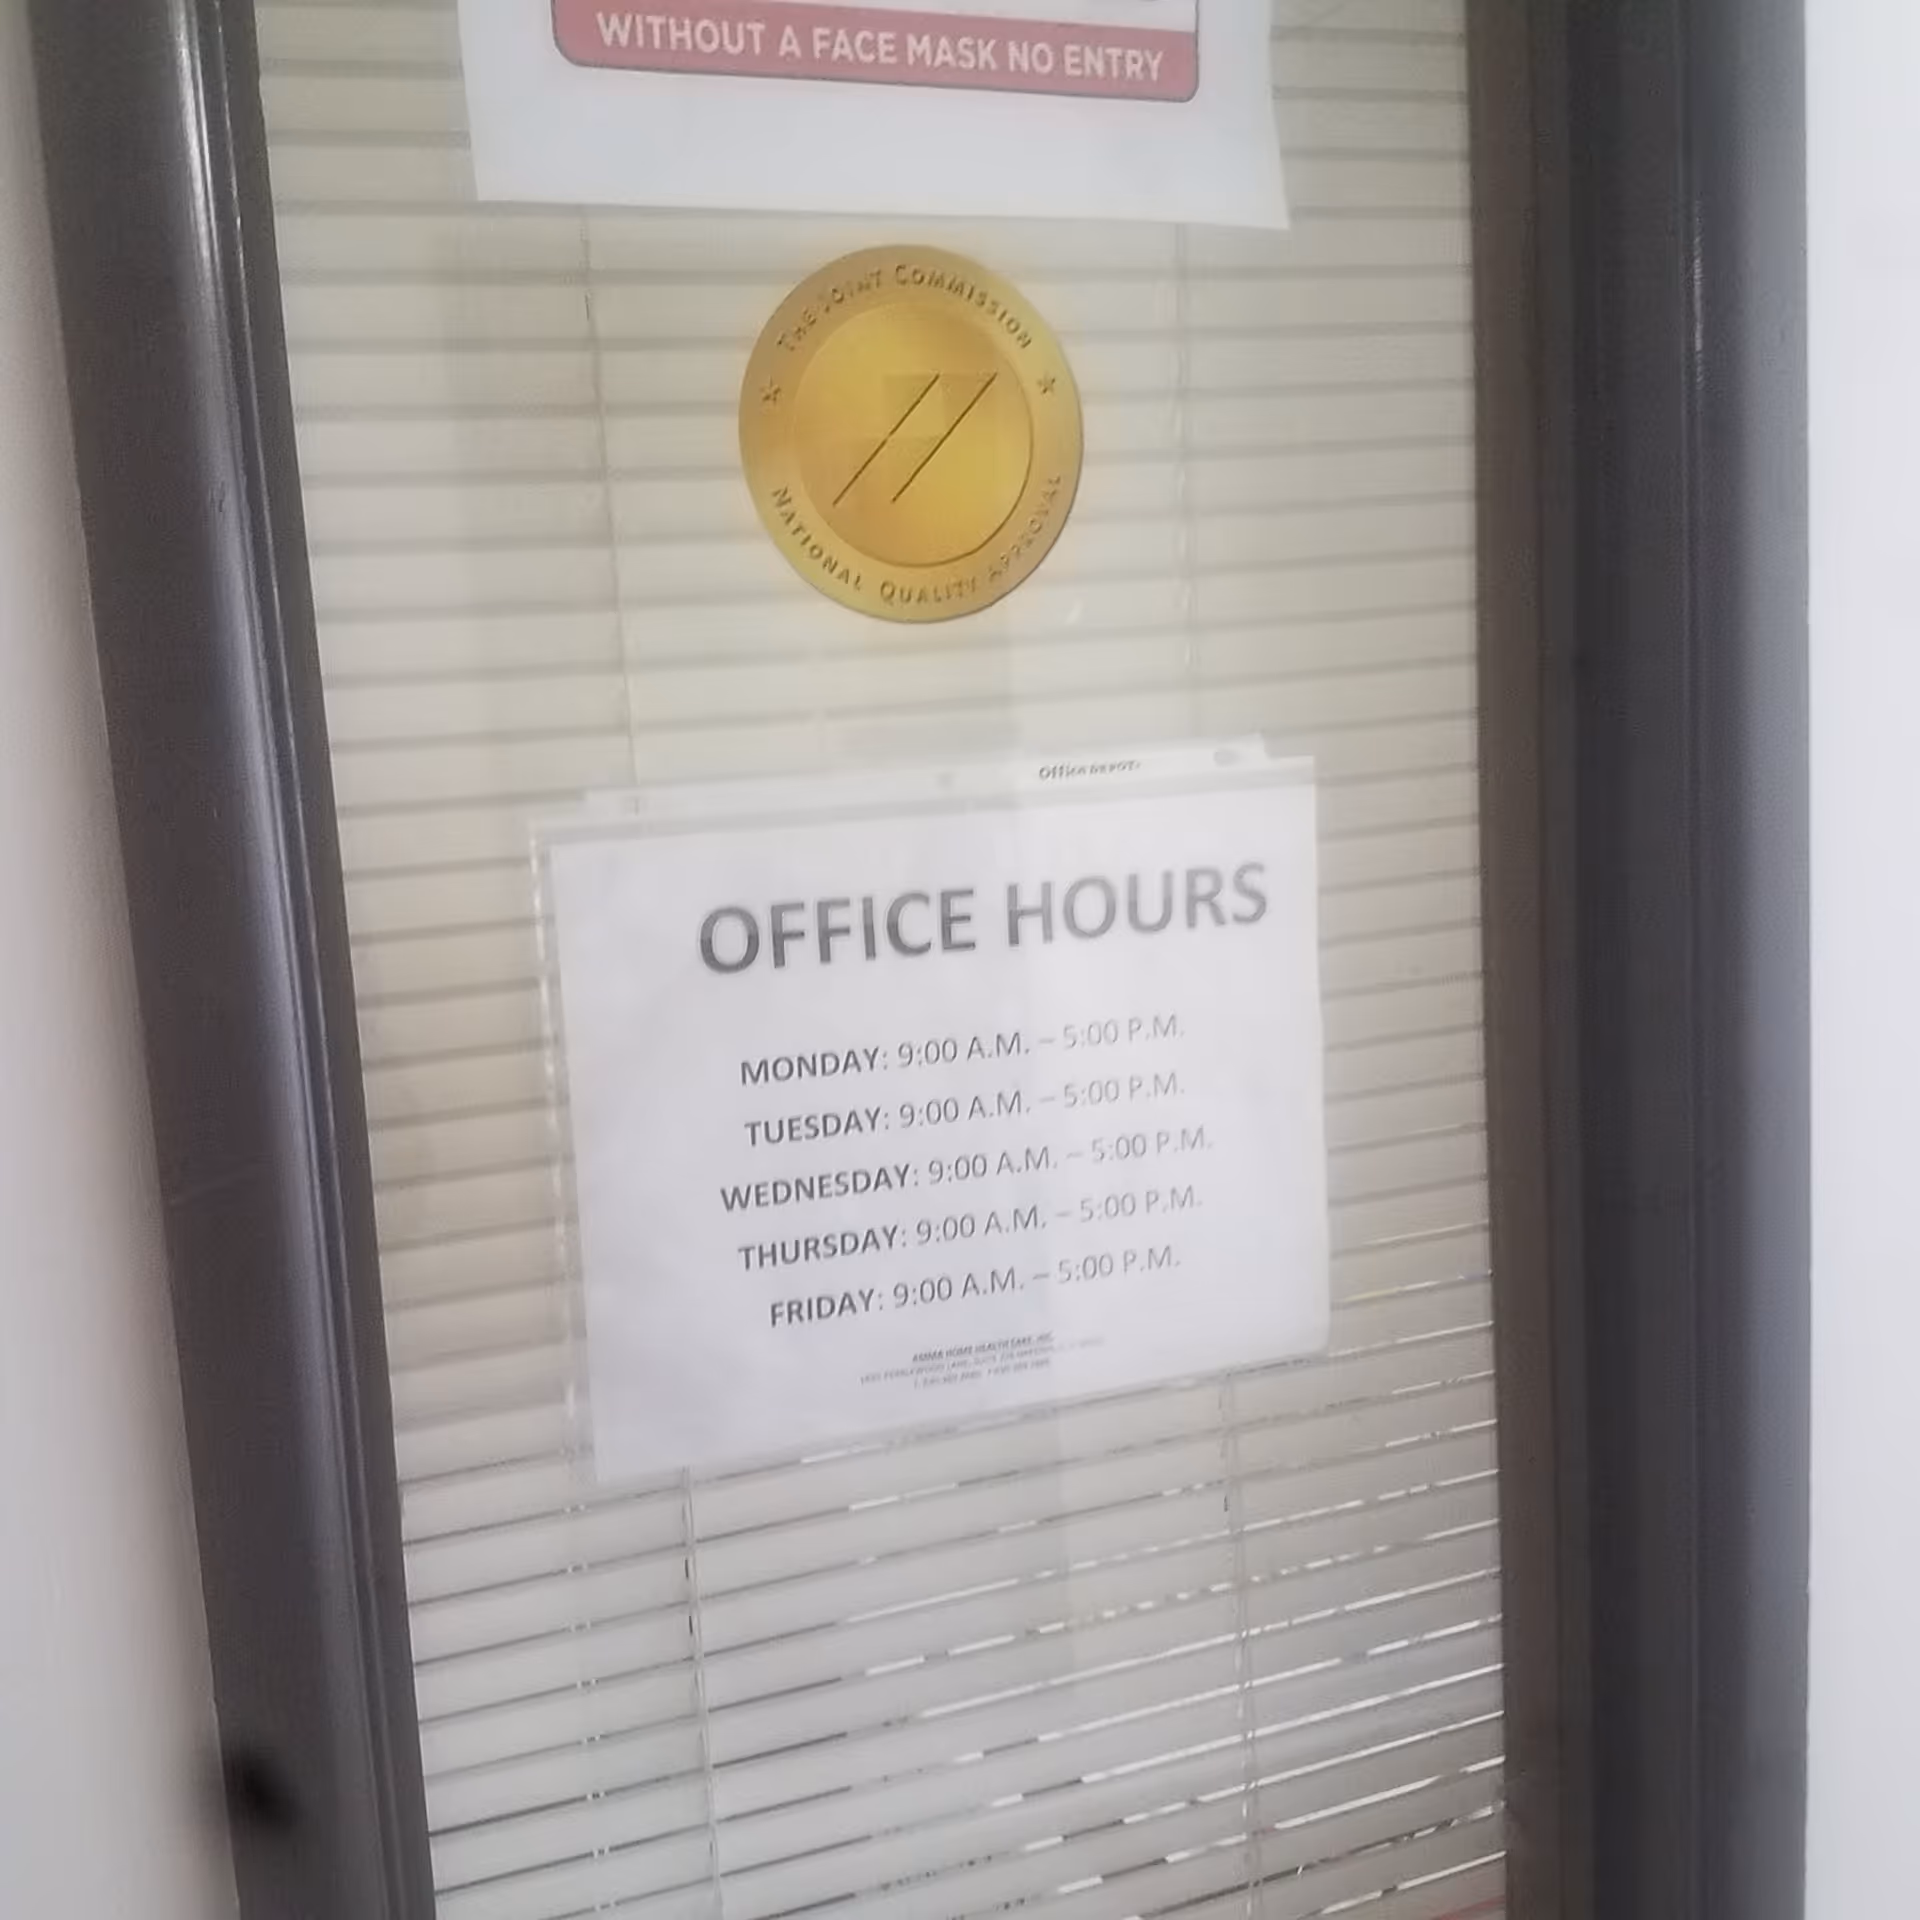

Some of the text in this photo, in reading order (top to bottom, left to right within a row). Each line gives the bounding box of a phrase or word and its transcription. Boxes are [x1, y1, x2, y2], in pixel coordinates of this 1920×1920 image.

[597, 12, 1163, 82] WITHOUT A FACE MASK NO ENTRY
[895, 264, 1032, 350] COMMISSION
[771, 485, 863, 592] NATIONAL
[880, 576, 977, 606] QUALITY
[699, 862, 1268, 974] OFFICE HOURS
[740, 1045, 889, 1086] MONDAY:
[897, 1037, 958, 1069] 9:00
[966, 1032, 1031, 1061] A.M.
[1063, 1019, 1119, 1050] 5:00
[1127, 1013, 1186, 1042] P.M.
[744, 1106, 891, 1147] TUESDAY:
[898, 1098, 960, 1129] 9:00
[967, 1090, 1032, 1121] A.M.
[1063, 1077, 1120, 1108] 5:00
[1128, 1071, 1186, 1100] P.M.
[720, 1163, 920, 1213] WEDNESDAY:
[927, 1154, 988, 1186] 9:00
[995, 1146, 1058, 1177] A.M.
[1091, 1132, 1148, 1164] 5:00
[1155, 1127, 1214, 1156] P.M.
[738, 1224, 908, 1272] THURSDAY:
[916, 1215, 977, 1246] 9:00
[984, 1206, 1047, 1237] A.M.
[1080, 1192, 1137, 1223] 5:00
[1145, 1185, 1204, 1215] P.M.
[770, 1288, 884, 1329] FRIDAY:
[892, 1277, 954, 1310] 9:00
[961, 1267, 1025, 1299] A.M.
[1058, 1254, 1114, 1285] 5:00
[1122, 1245, 1182, 1275] P.M.
